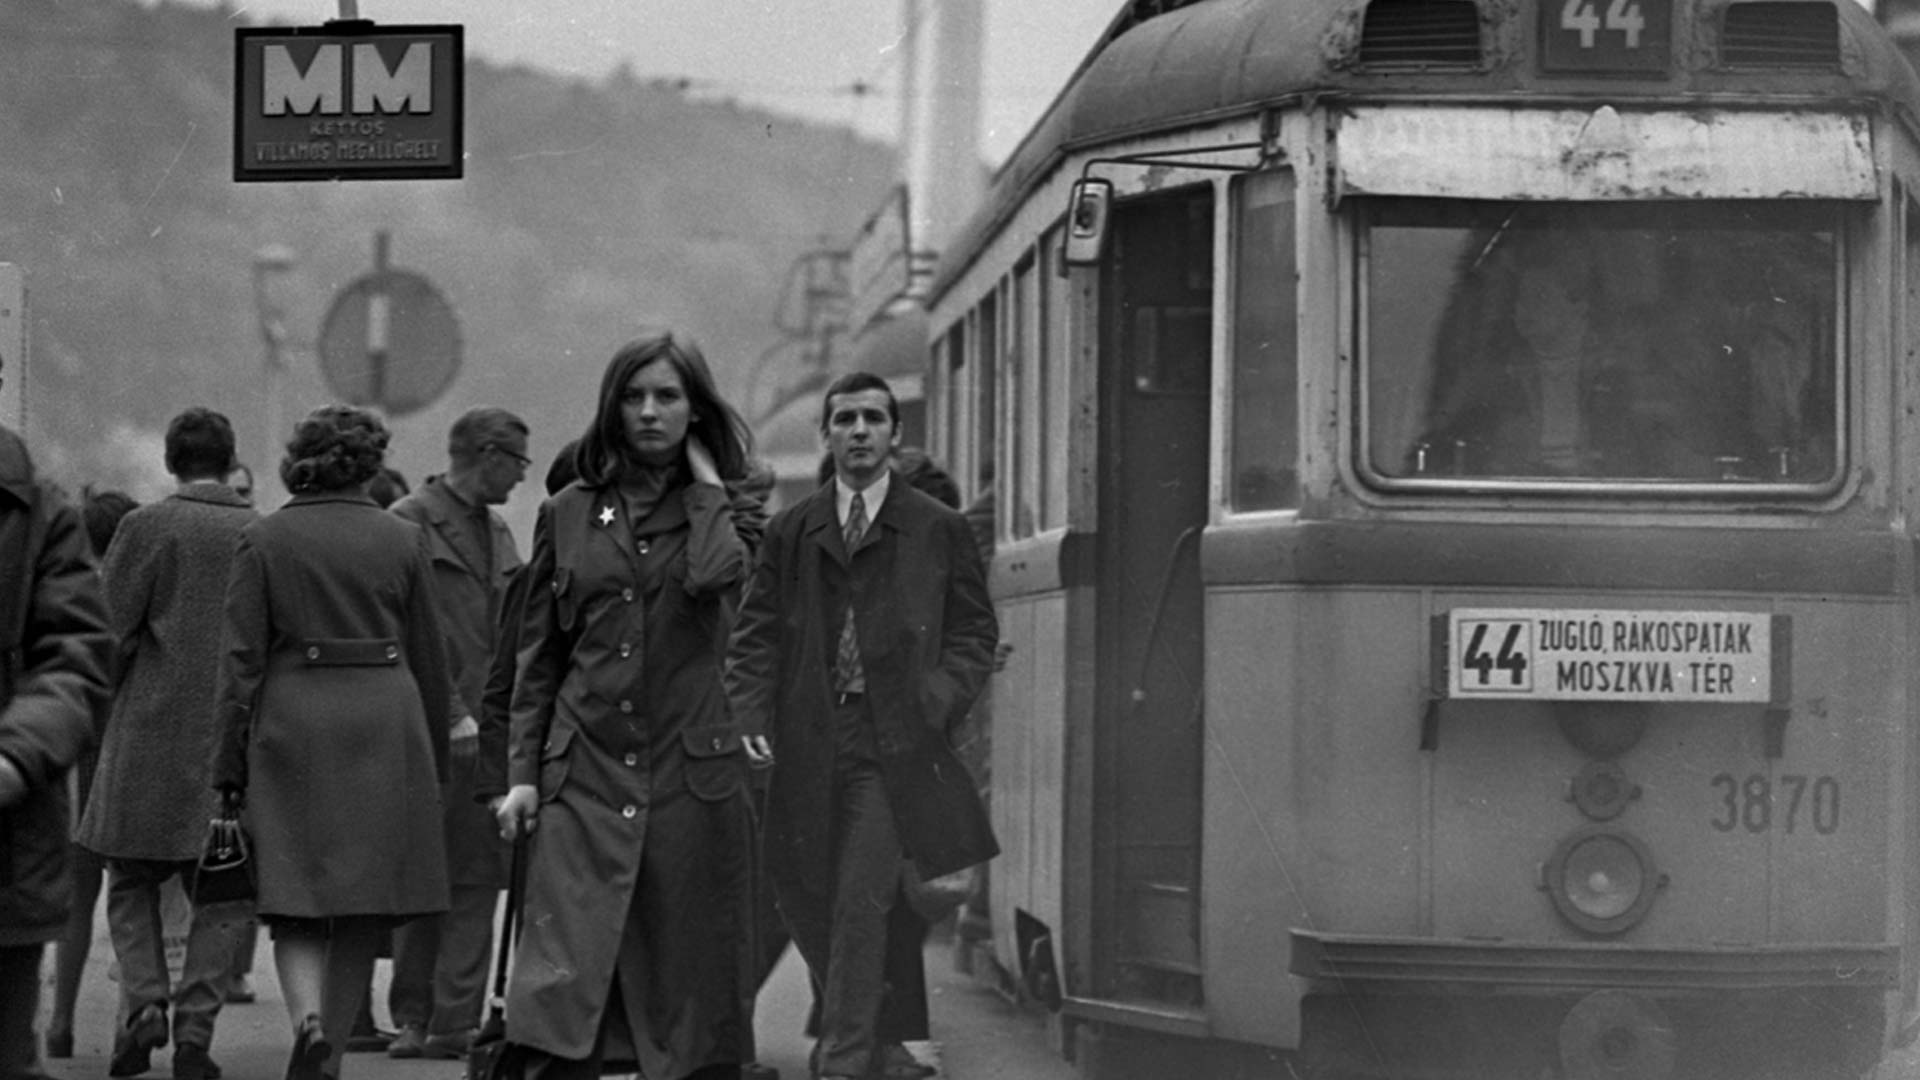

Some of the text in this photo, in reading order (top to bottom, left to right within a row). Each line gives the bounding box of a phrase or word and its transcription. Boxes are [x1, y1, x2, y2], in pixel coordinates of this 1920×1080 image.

[1561, 0, 1645, 48] 44
[263, 43, 432, 115] MM
[256, 141, 331, 161] VILLAMOS
[1463, 623, 1527, 685] 44
[1539, 614, 1752, 654] ZUGLÓ, RÁKOSPATAK
[1557, 656, 1733, 694] MOSZKVA TÉR
[1710, 772, 1840, 835] 3870
